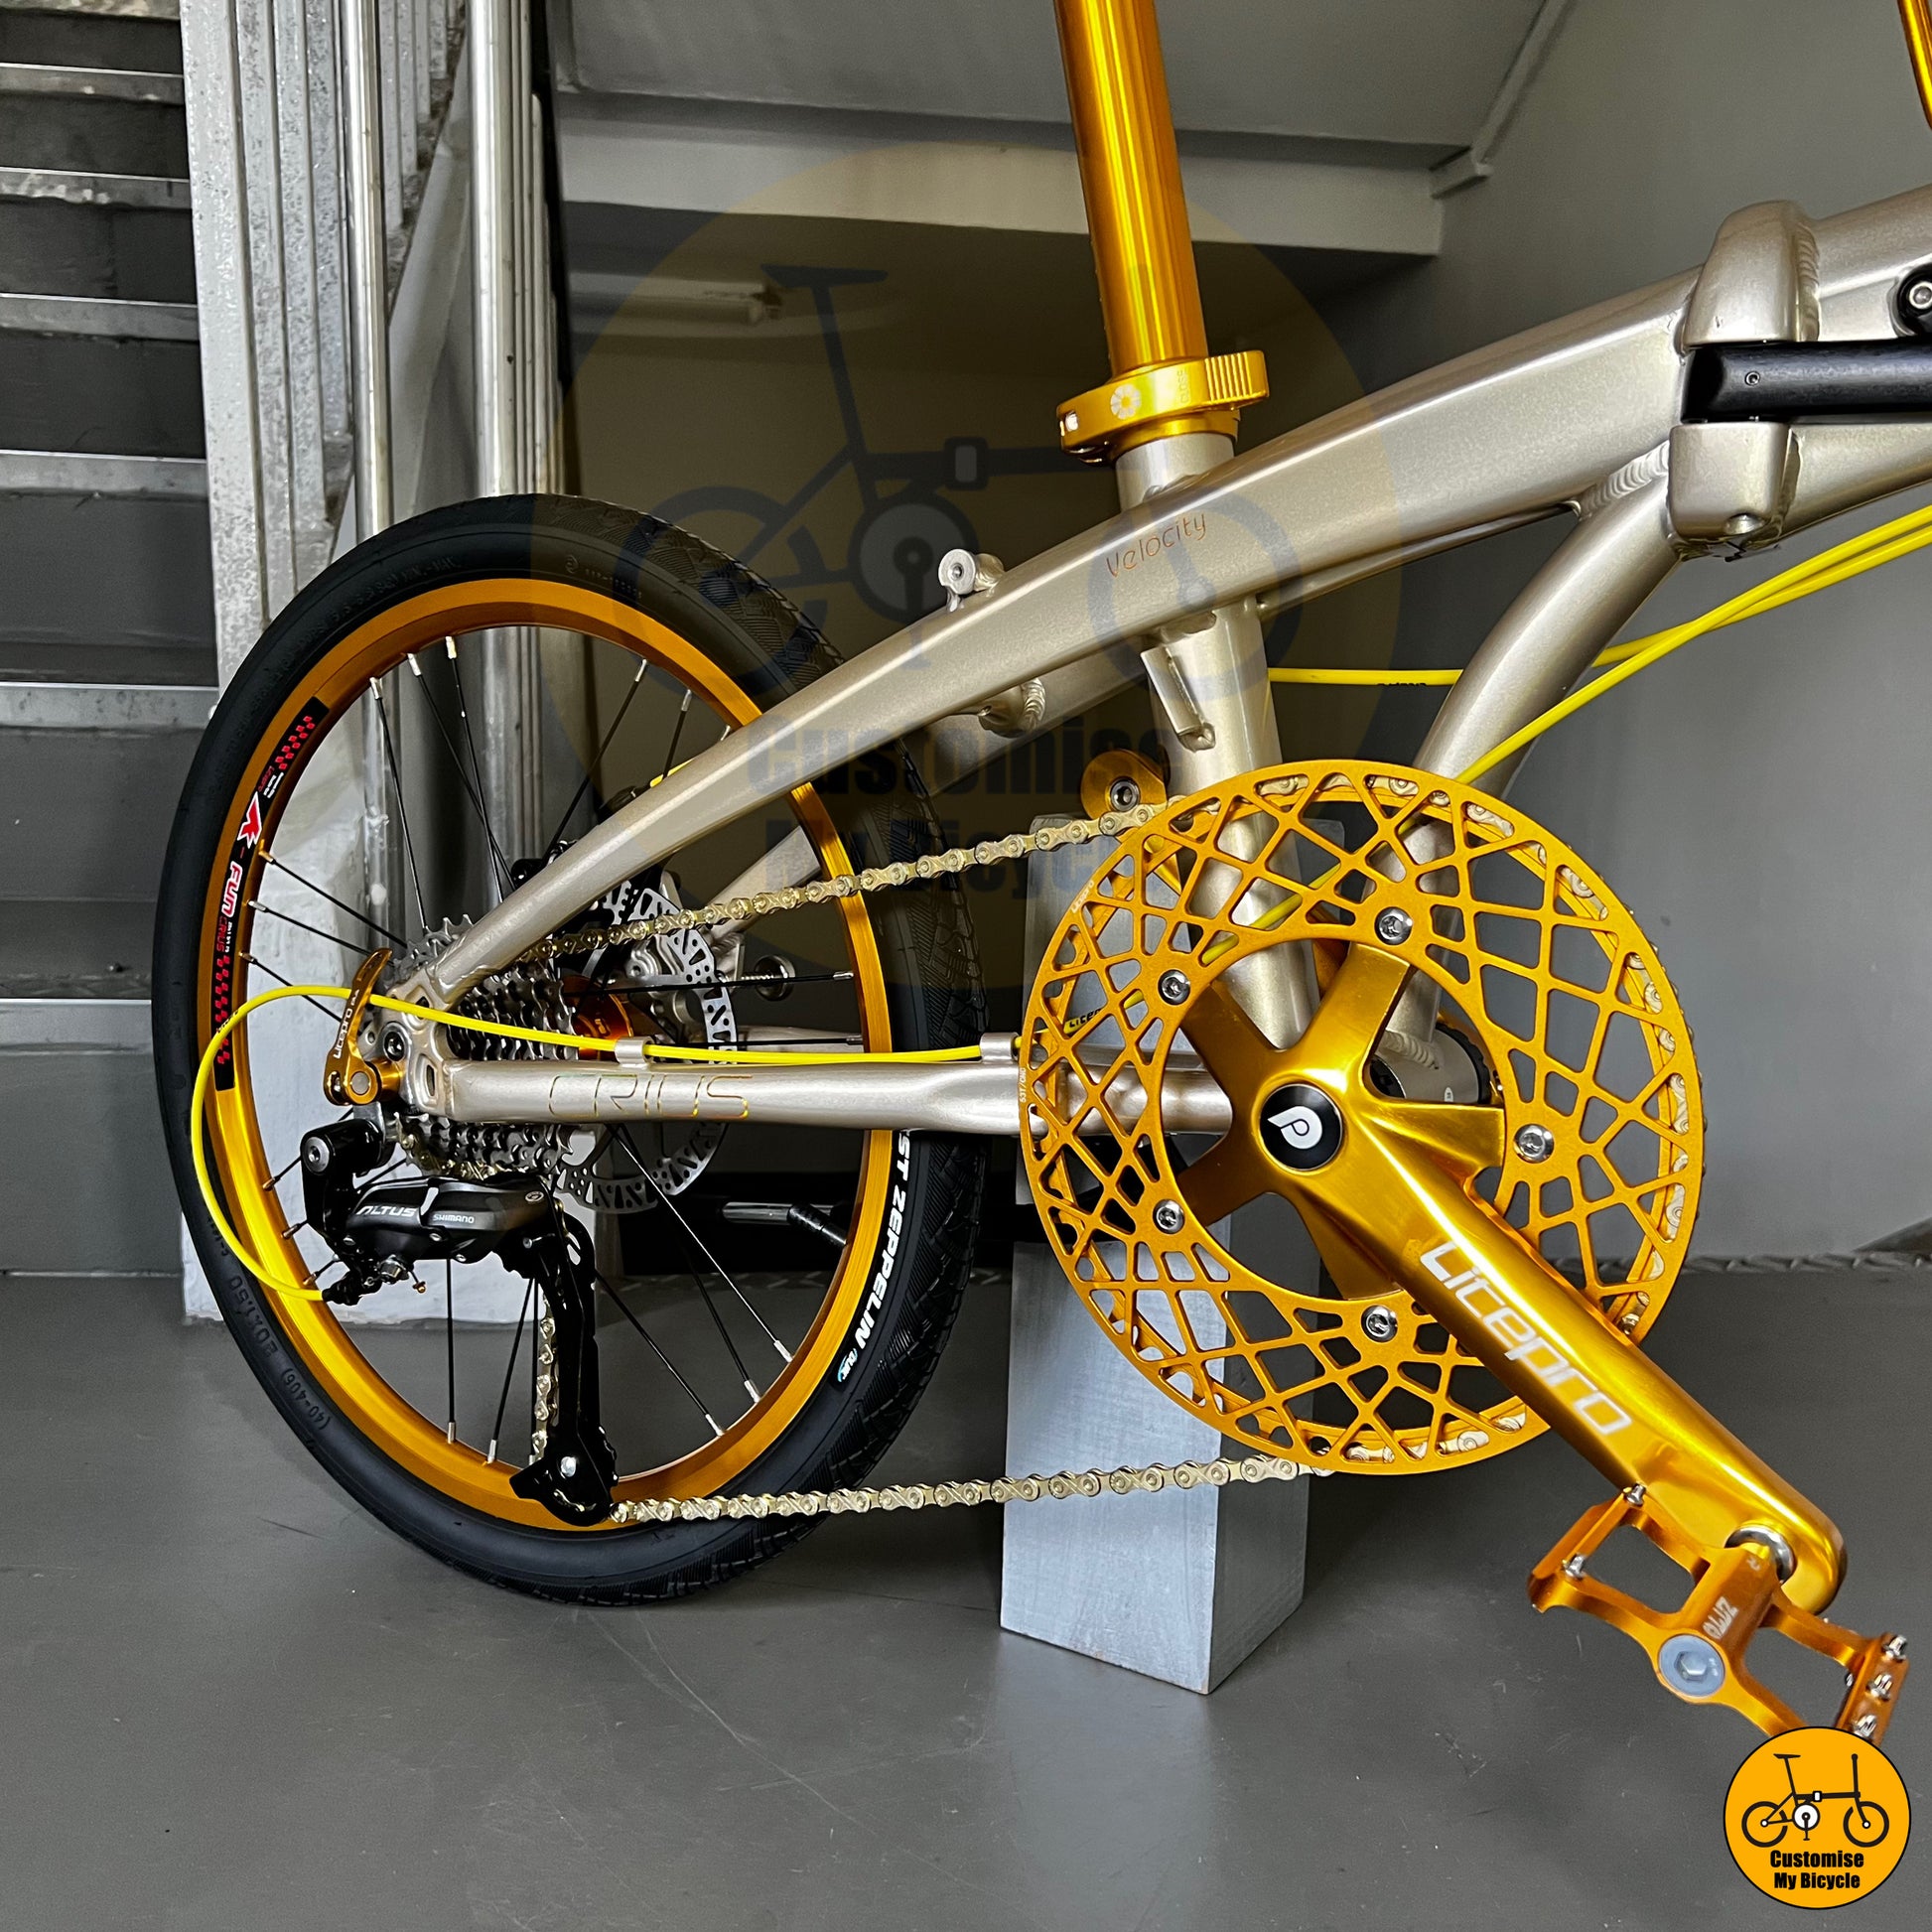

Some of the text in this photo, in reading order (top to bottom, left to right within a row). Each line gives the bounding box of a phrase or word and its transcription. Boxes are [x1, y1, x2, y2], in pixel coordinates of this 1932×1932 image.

[1105, 513, 1206, 578] Velocity
[548, 1073, 753, 1119] CRIUS
[356, 1205, 417, 1218] ALTUS
[433, 1213, 475, 1224] SHIMANO
[855, 1130, 910, 1350] ST ZEPPELIN
[1420, 1240, 1633, 1436] Litepro
[281, 1367, 332, 1431] (40-406)
